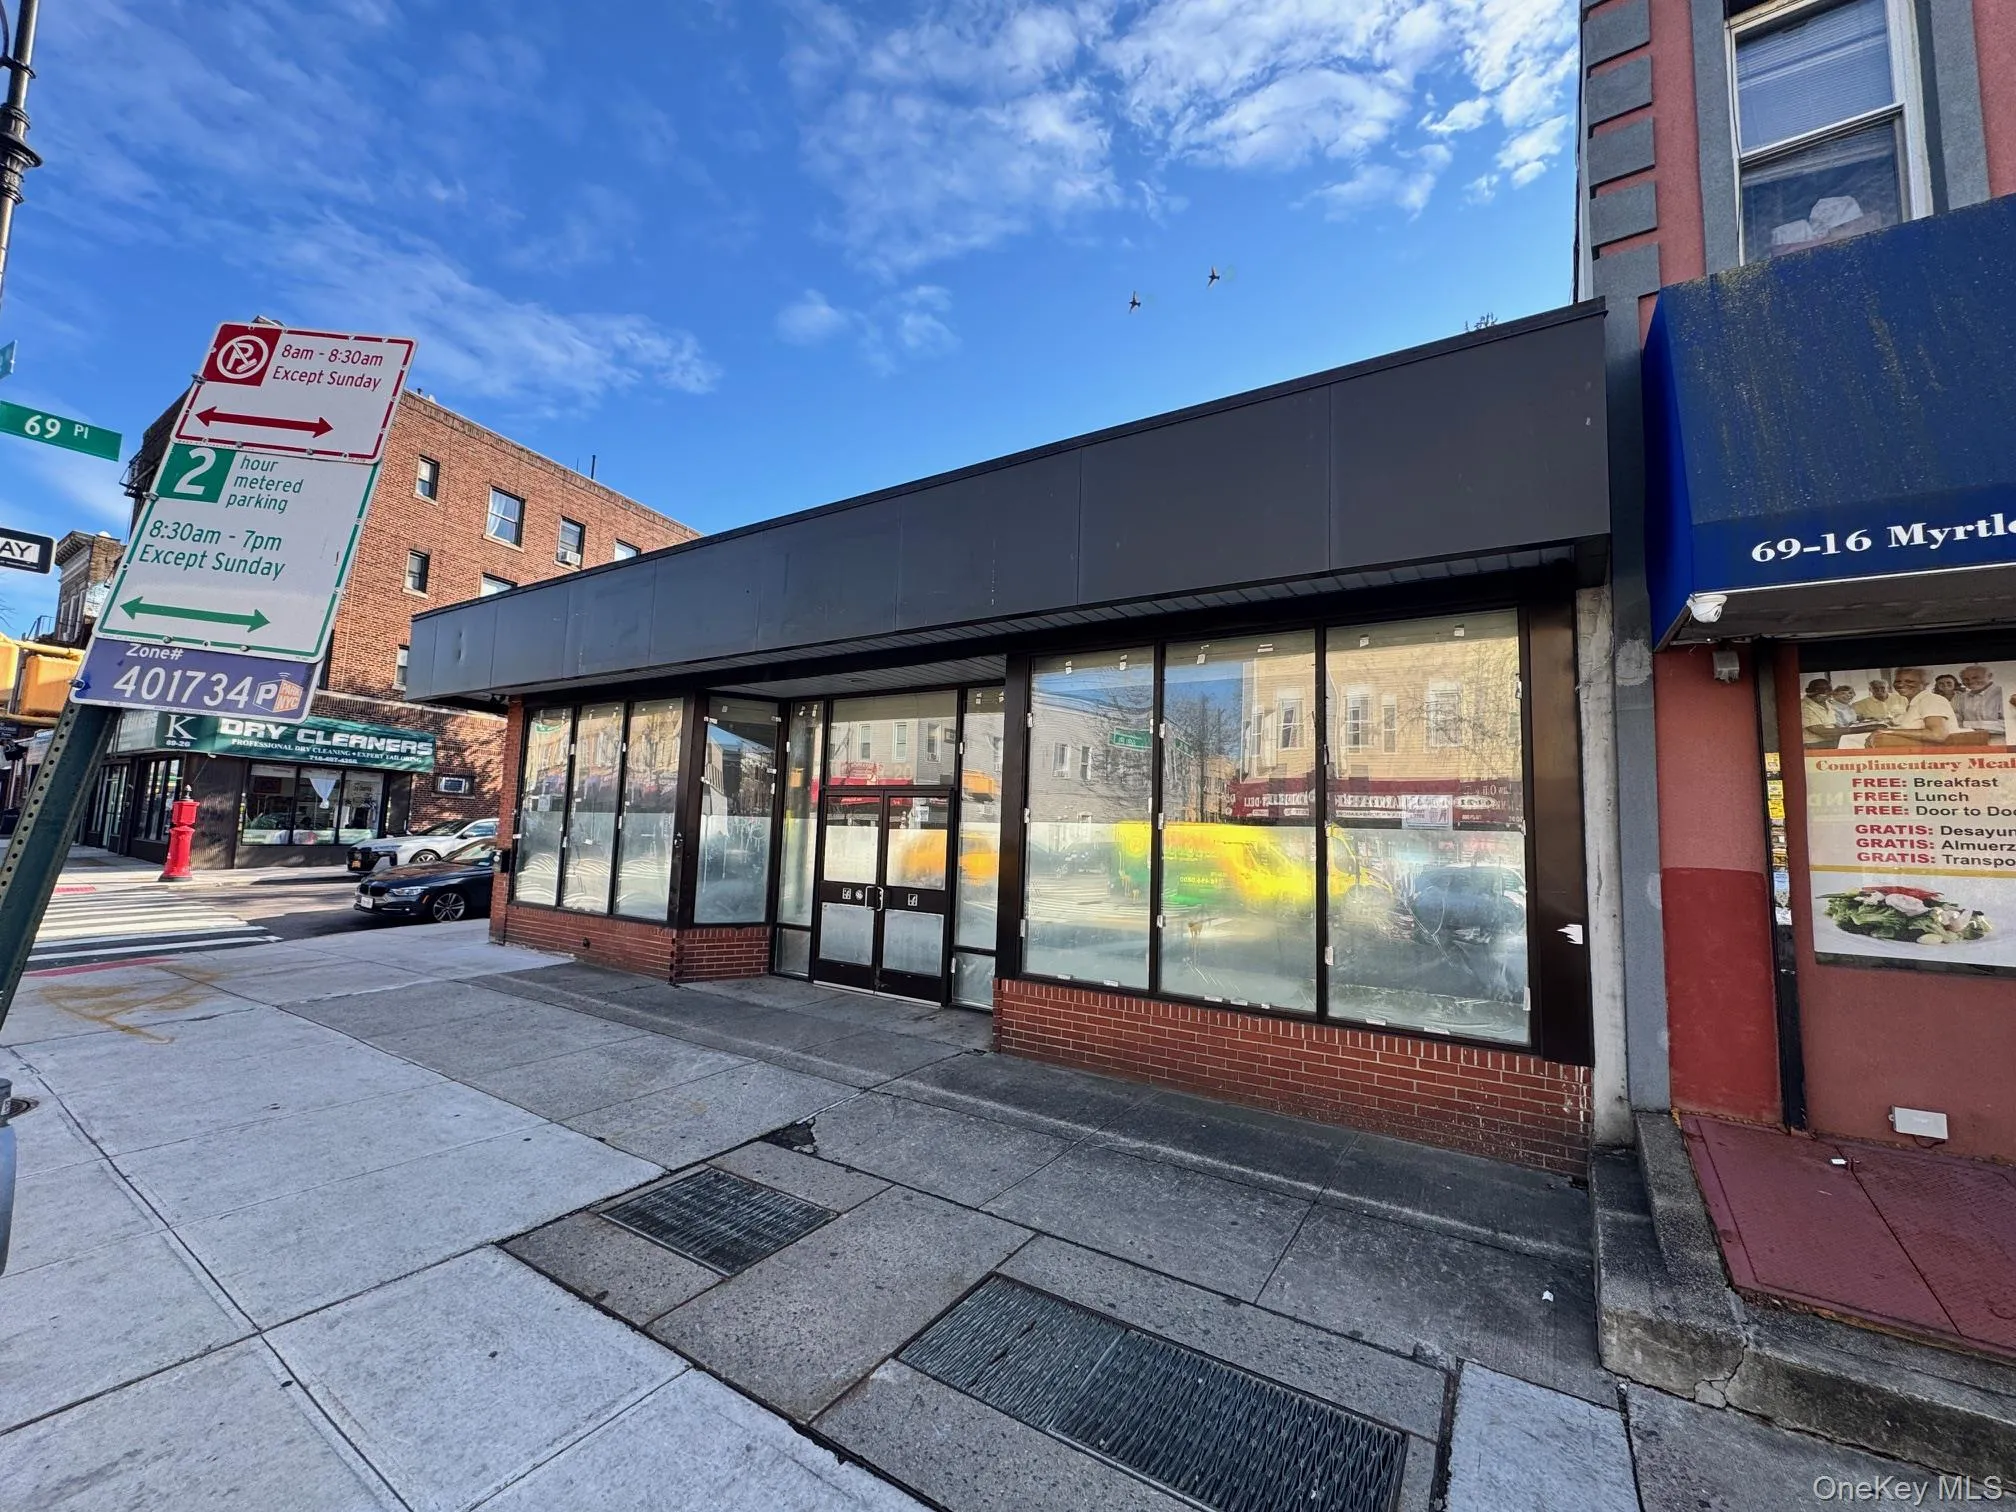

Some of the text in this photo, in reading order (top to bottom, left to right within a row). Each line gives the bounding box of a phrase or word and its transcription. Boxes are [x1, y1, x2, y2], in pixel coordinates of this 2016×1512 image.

[281, 344, 314, 360] 8am
[328, 348, 383, 366] 8:30am
[273, 366, 382, 392] Except Sunday
[24, 415, 61, 439] 69
[173, 446, 279, 495] 2 hour
[233, 475, 304, 493] metered
[225, 493, 289, 514] parking
[149, 520, 222, 544] 8:30am
[243, 530, 282, 553] 7pm
[1751, 529, 1872, 562] 69-16
[139, 544, 286, 581] Except Sunday
[126, 643, 184, 660] Zone#
[113, 665, 253, 709] 401734
[256, 682, 302, 705] P PARK
[276, 694, 300, 710] NYC
[165, 714, 198, 740] K
[219, 718, 433, 755] DRY CLEANERS
[232, 738, 293, 750] PROFESSIONAL
[294, 745, 312, 753] DRY
[312, 748, 351, 756] CLEANING
[356, 752, 385, 760] EXPERT
[1815, 758, 2016, 773] Complimentary Meal
[1852, 777, 1999, 788] FREE: Breakfast
[1853, 791, 1969, 802] FREE: Lunch
[1854, 805, 1909, 815] FREE:
[1916, 806, 1958, 816] Door
[1964, 806, 1981, 816] to
[1855, 824, 2016, 839] GRATIS: Desayun
[1856, 838, 2016, 851] GRATIS: Almuerz
[1857, 852, 2016, 868] GRATIS: Transpo
